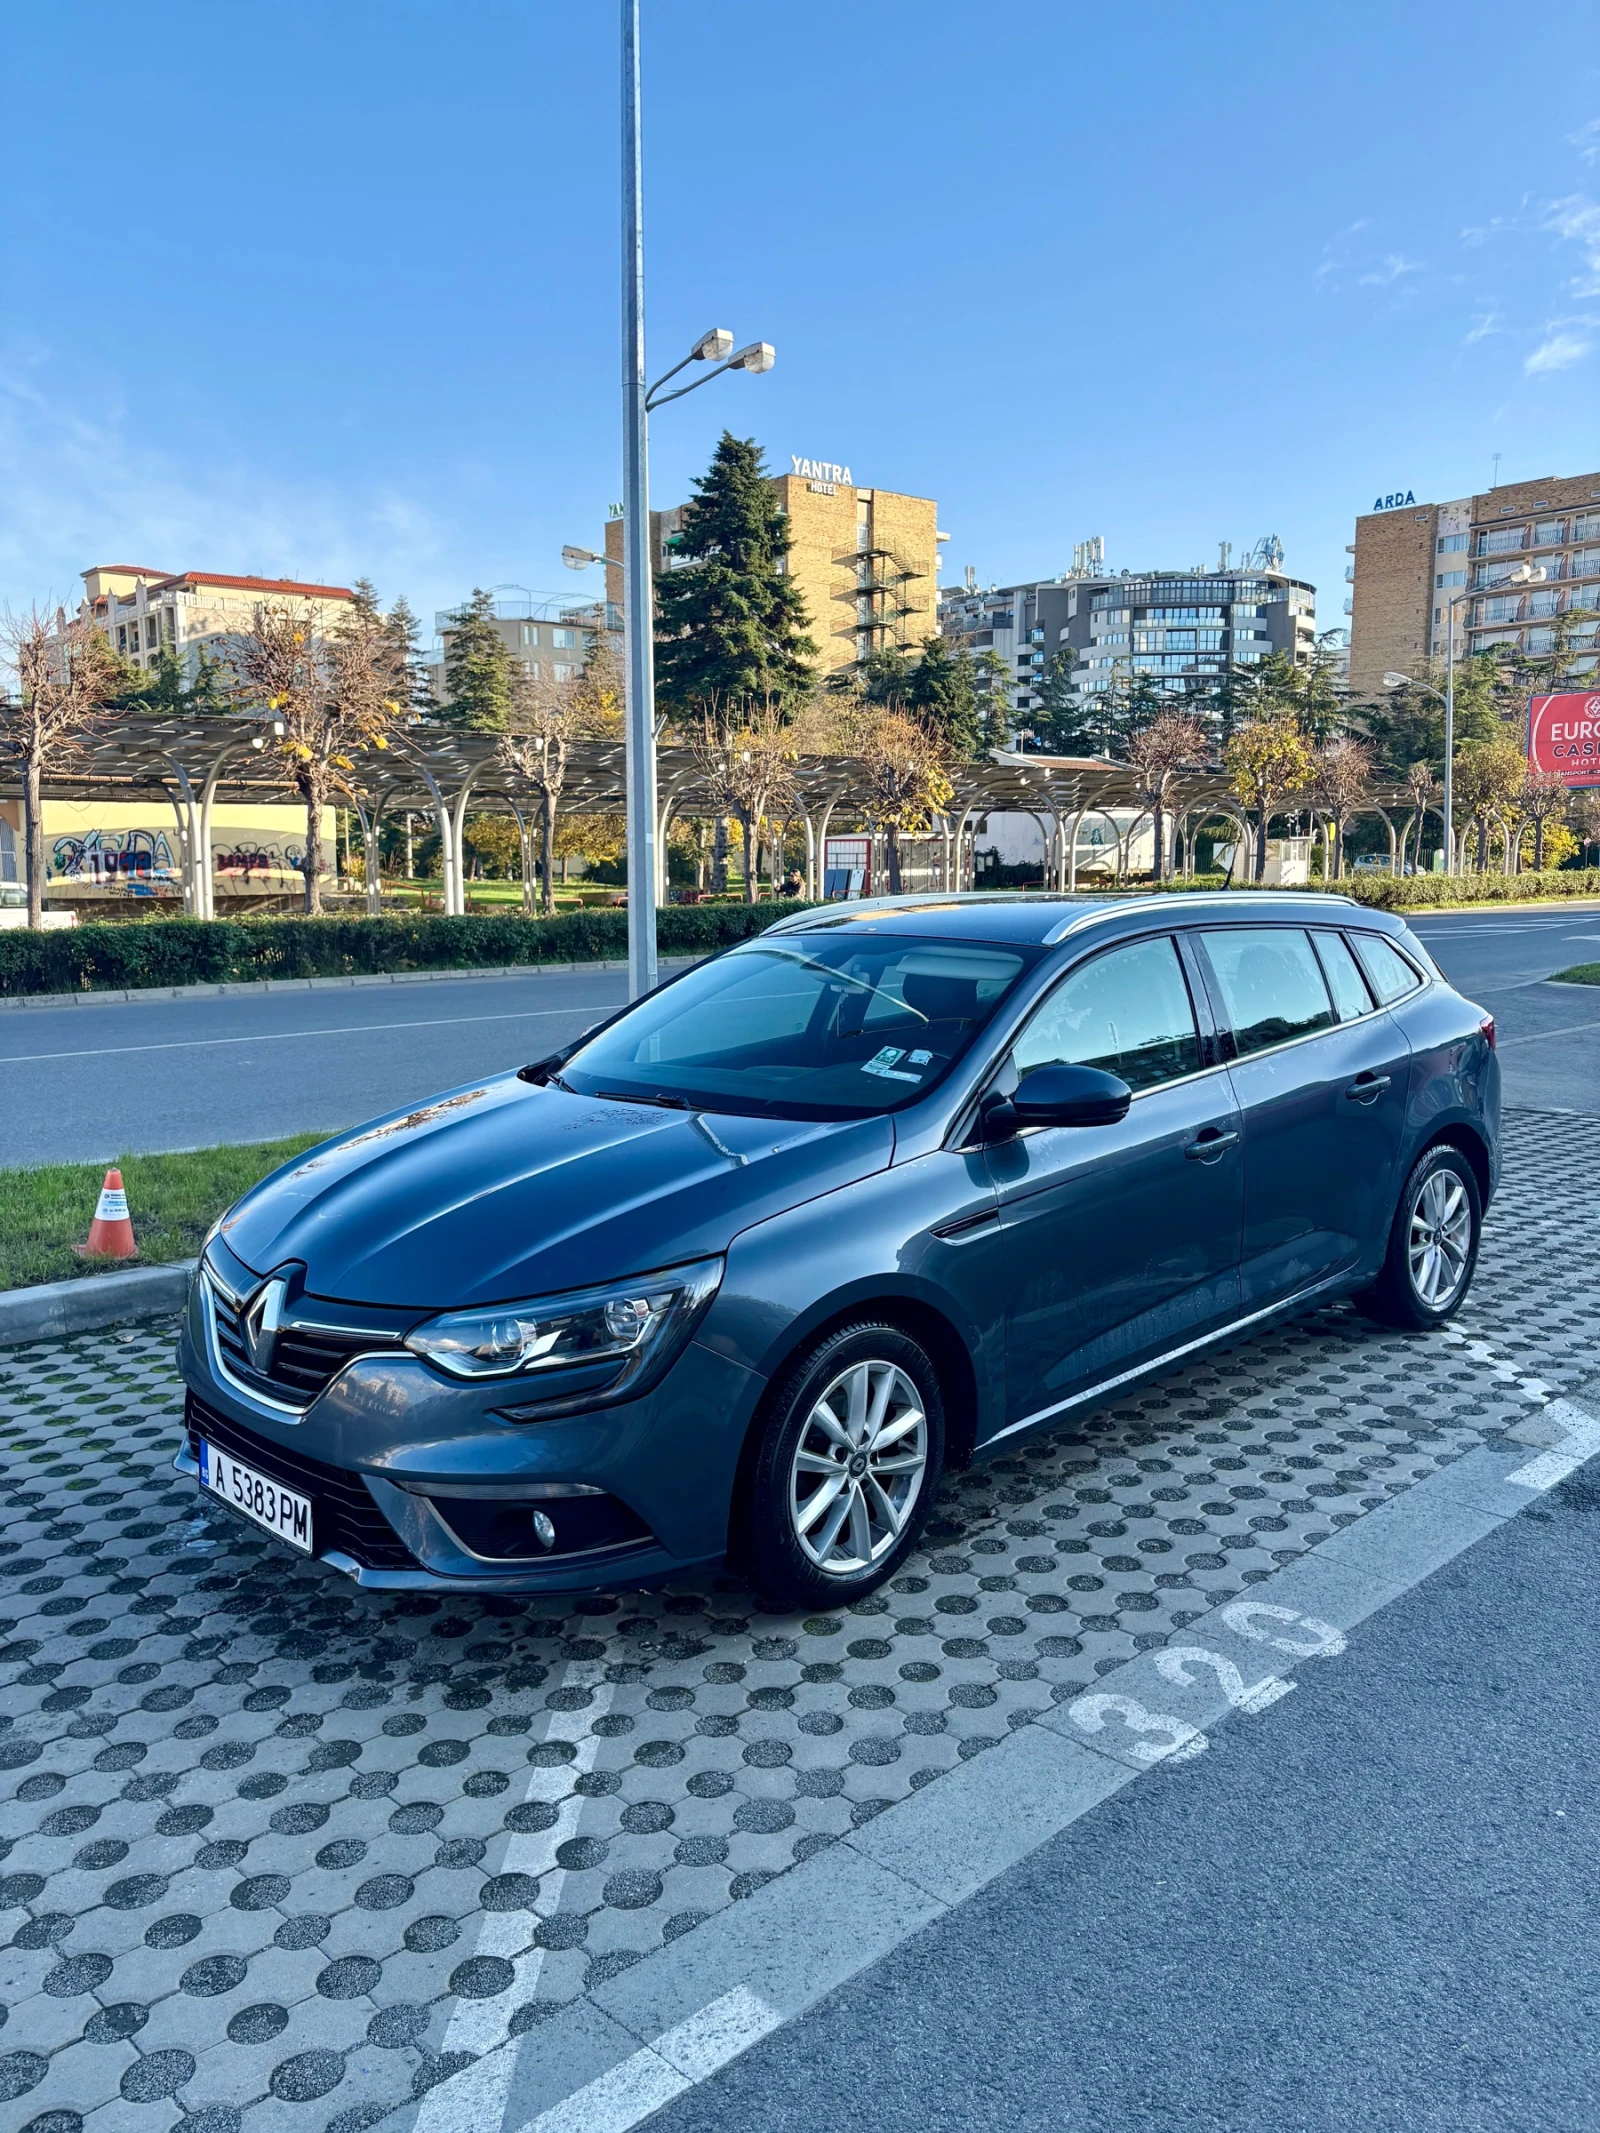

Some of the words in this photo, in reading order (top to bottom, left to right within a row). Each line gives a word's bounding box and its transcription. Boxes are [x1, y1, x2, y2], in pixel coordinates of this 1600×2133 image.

[791, 454, 853, 486] YANTRA
[810, 481, 836, 496] HOTEL
[609, 502, 624, 518] YAN
[1373, 490, 1416, 511] ARDA
[1571, 757, 1600, 767] HOT
[216, 1455, 226, 1493] A
[232, 1465, 276, 1523] 5383
[280, 1492, 308, 1543] PM
[1069, 1602, 1348, 1763] 320
